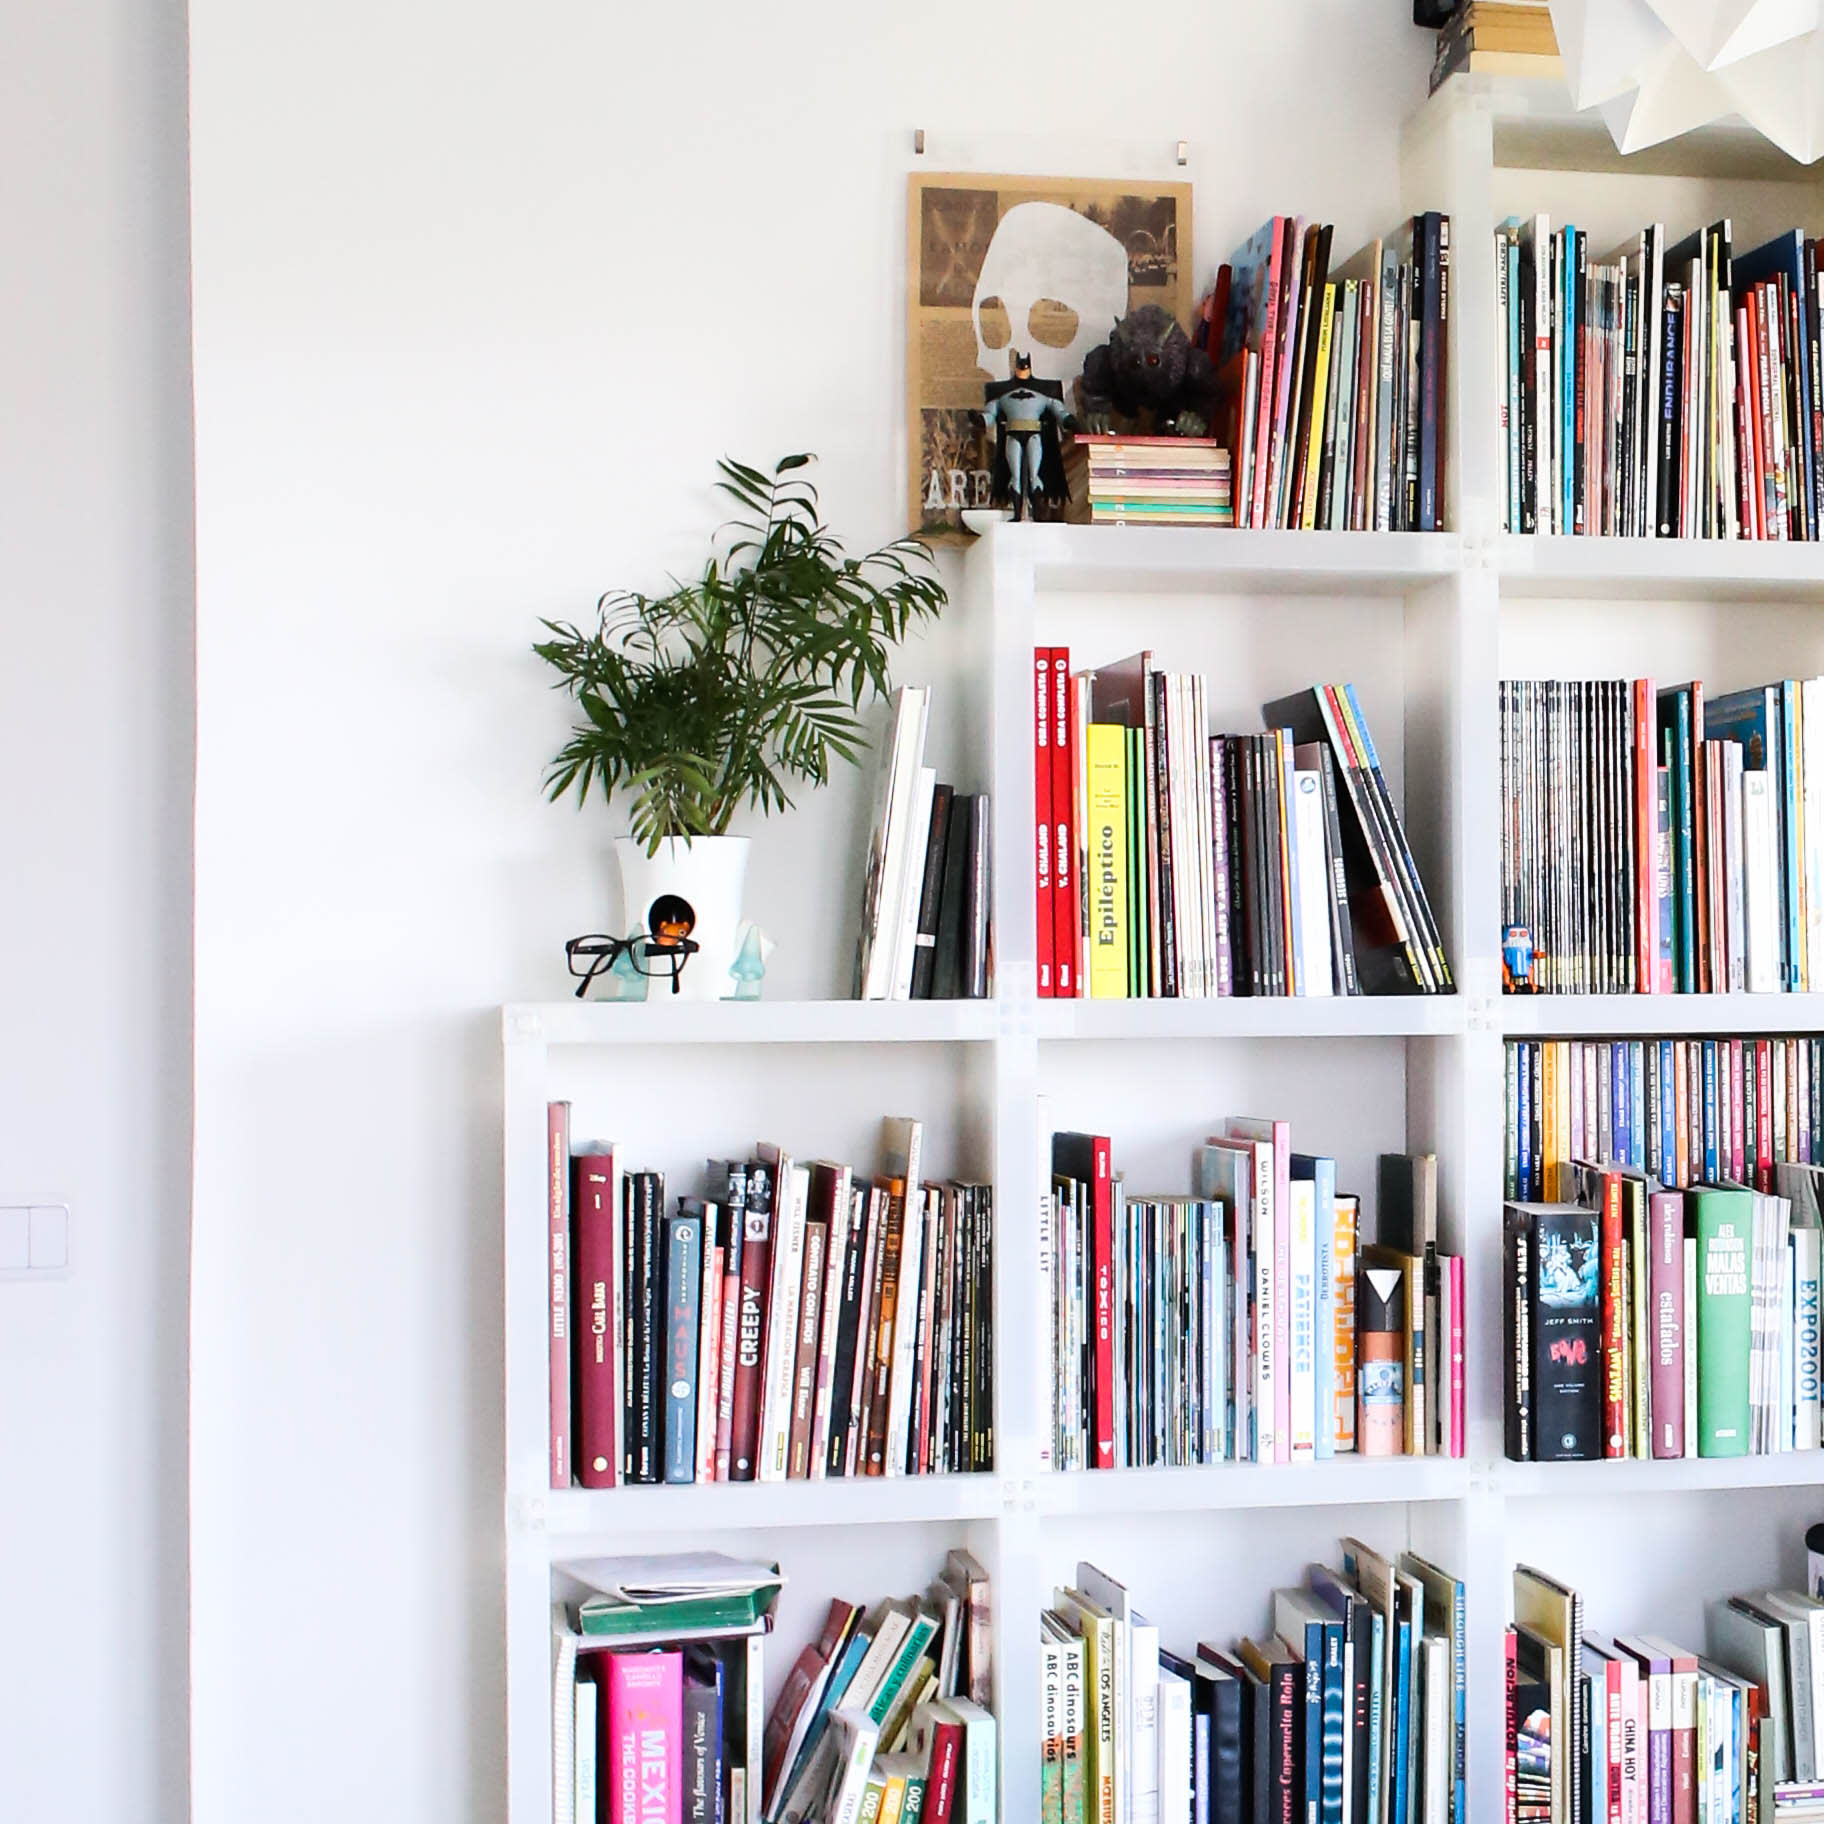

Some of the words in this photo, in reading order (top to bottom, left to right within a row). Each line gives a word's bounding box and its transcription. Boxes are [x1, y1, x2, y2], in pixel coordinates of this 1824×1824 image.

[1663, 312, 1677, 420] ENDURANCE
[1037, 672, 1048, 721] COMPLETA
[1056, 672, 1067, 721] COMPLETA
[1037, 722, 1048, 747] OBRA
[1056, 722, 1067, 747] OBRA
[1038, 824, 1049, 876] CHALAND
[1057, 824, 1068, 876] CHALAND
[1093, 824, 1119, 947] Epiléptico
[1260, 1160, 1271, 1216] WILSON
[1663, 1203, 1674, 1222] alex
[1516, 1237, 1528, 1273] SETH
[1663, 1224, 1674, 1264] robinson
[806, 1235, 822, 1290] CONTRATO
[1706, 1252, 1747, 1275] MALAS
[553, 1273, 564, 1303] NEMO
[590, 1282, 605, 1307] BARKS
[1260, 1267, 1271, 1318] DANIEL
[1704, 1274, 1747, 1296] VENTAS
[590, 1306, 606, 1335] CARL
[804, 1292, 818, 1316] CON
[553, 1305, 565, 1338] LITTLE
[739, 1286, 761, 1367] CREEPY
[803, 1318, 817, 1345] DIOS
[1294, 1273, 1311, 1373] PATIENCE
[1544, 1318, 1566, 1327] JEFF
[1569, 1318, 1594, 1327] SMITH
[1659, 1291, 1679, 1367] estafados
[1261, 1319, 1272, 1381] CLOWES
[1800, 1278, 1818, 1403] EXPO2001
[800, 1367, 813, 1385] Will
[797, 1387, 809, 1420] Eisner
[639, 1446, 650, 1476] forum
[1046, 1652, 1060, 1679] ABC
[1063, 1651, 1081, 1681] ABC
[1101, 1667, 1113, 1690] LOS
[1278, 1673, 1294, 1705] Roja
[1505, 1657, 1517, 1753] ROTULACION
[691, 1711, 706, 1744] Venice
[1046, 1680, 1060, 1763] dinosaurios
[1063, 1683, 1081, 1760] dinosaurs
[1100, 1692, 1113, 1743] ANGELES
[622, 1732, 637, 1764] THE
[691, 1745, 706, 1757] of
[1278, 1709, 1295, 1785] Caperucita
[1624, 1717, 1637, 1755] CHINA
[691, 1757, 707, 1797] flavours
[1505, 1757, 1517, 1771] la
[1624, 1756, 1637, 1781] HOY
[905, 1785, 922, 1813] 200
[1506, 1774, 1517, 1792] de
[691, 1798, 706, 1818] The
[861, 1791, 880, 1819] 200
[1279, 1790, 1294, 1824] veces
